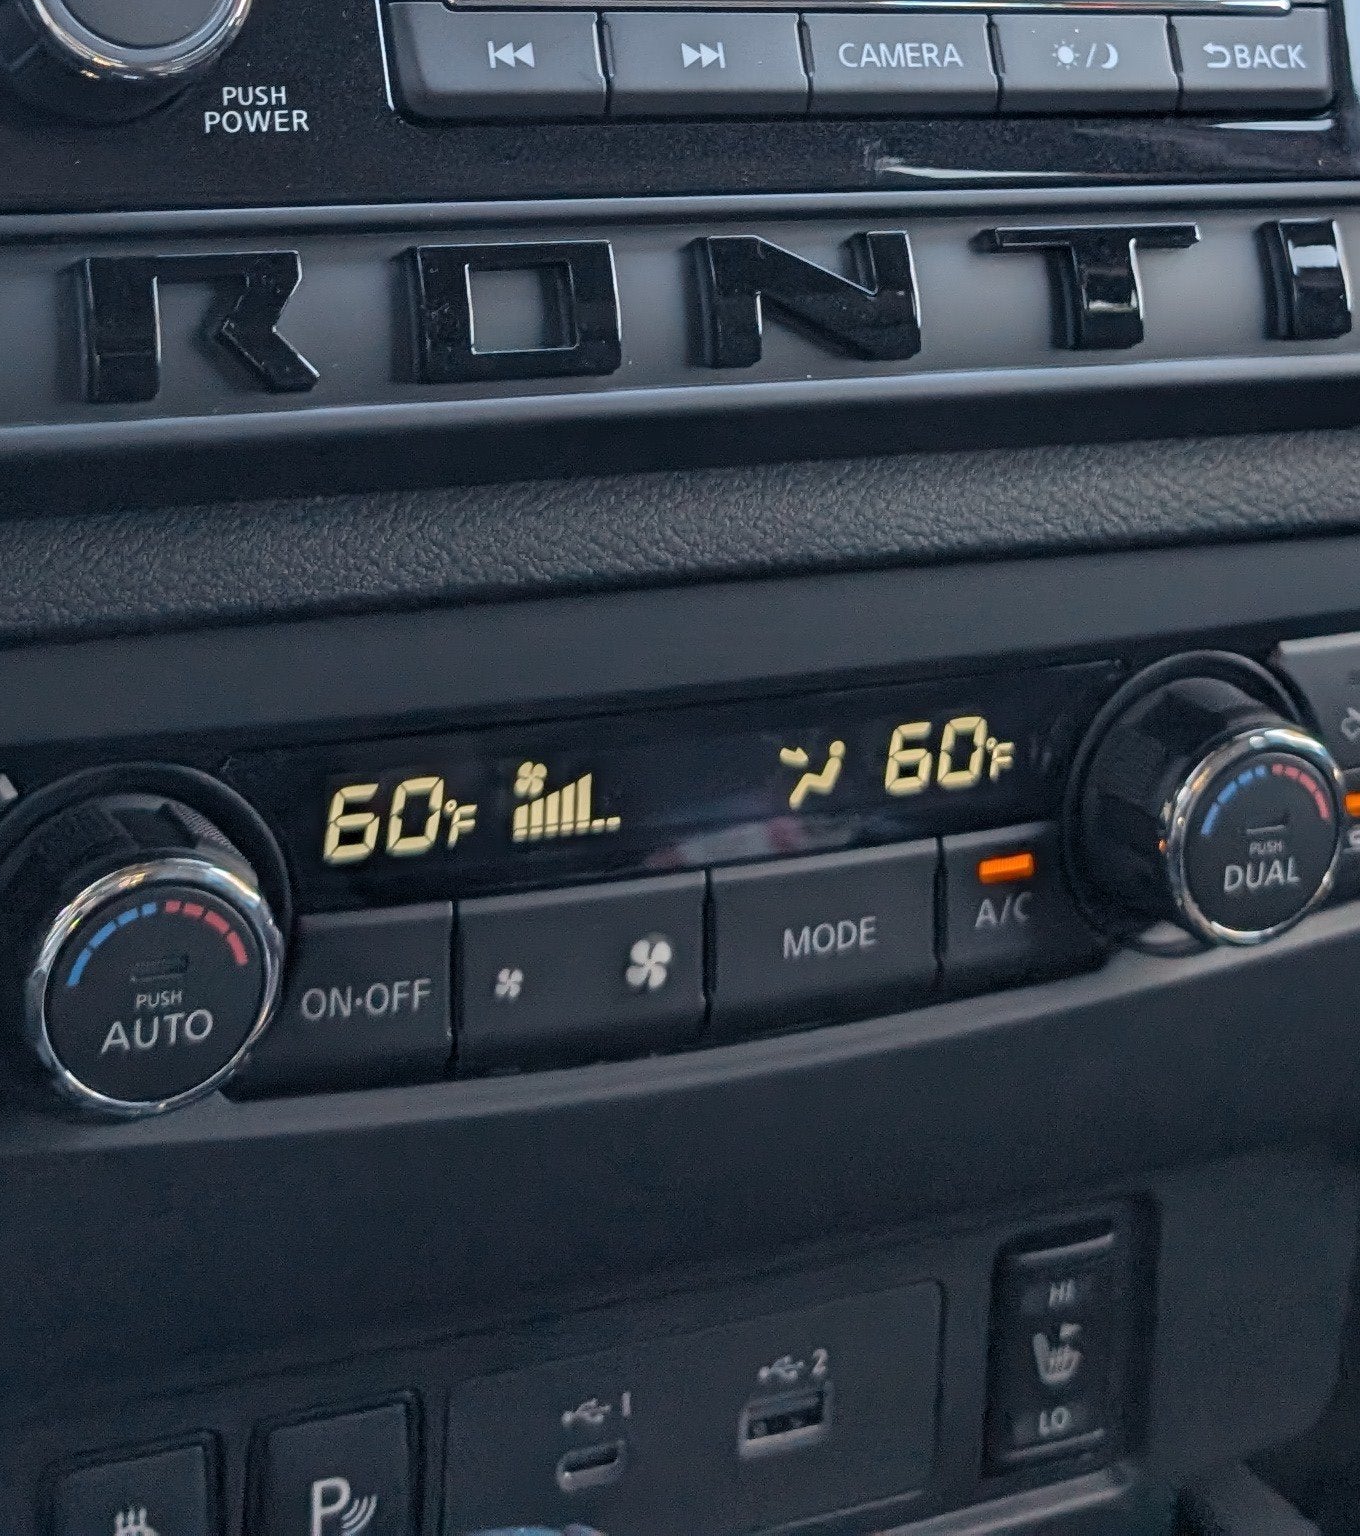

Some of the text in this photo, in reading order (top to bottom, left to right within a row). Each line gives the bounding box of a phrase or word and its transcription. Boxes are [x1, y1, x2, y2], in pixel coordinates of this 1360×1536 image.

[838, 44, 962, 70] CAMERA
[1234, 44, 1308, 70] BACK
[222, 86, 287, 107] PUSH
[203, 110, 310, 134] POWER
[1248, 840, 1284, 857] PUSH
[1222, 858, 1301, 894] DUAL
[974, 892, 1033, 930] A/C
[782, 917, 878, 959] MODE
[135, 989, 183, 1009] PUSH
[101, 1009, 214, 1056] AUTO
[1048, 1280, 1077, 1304] HI
[1038, 1406, 1071, 1435] LO
